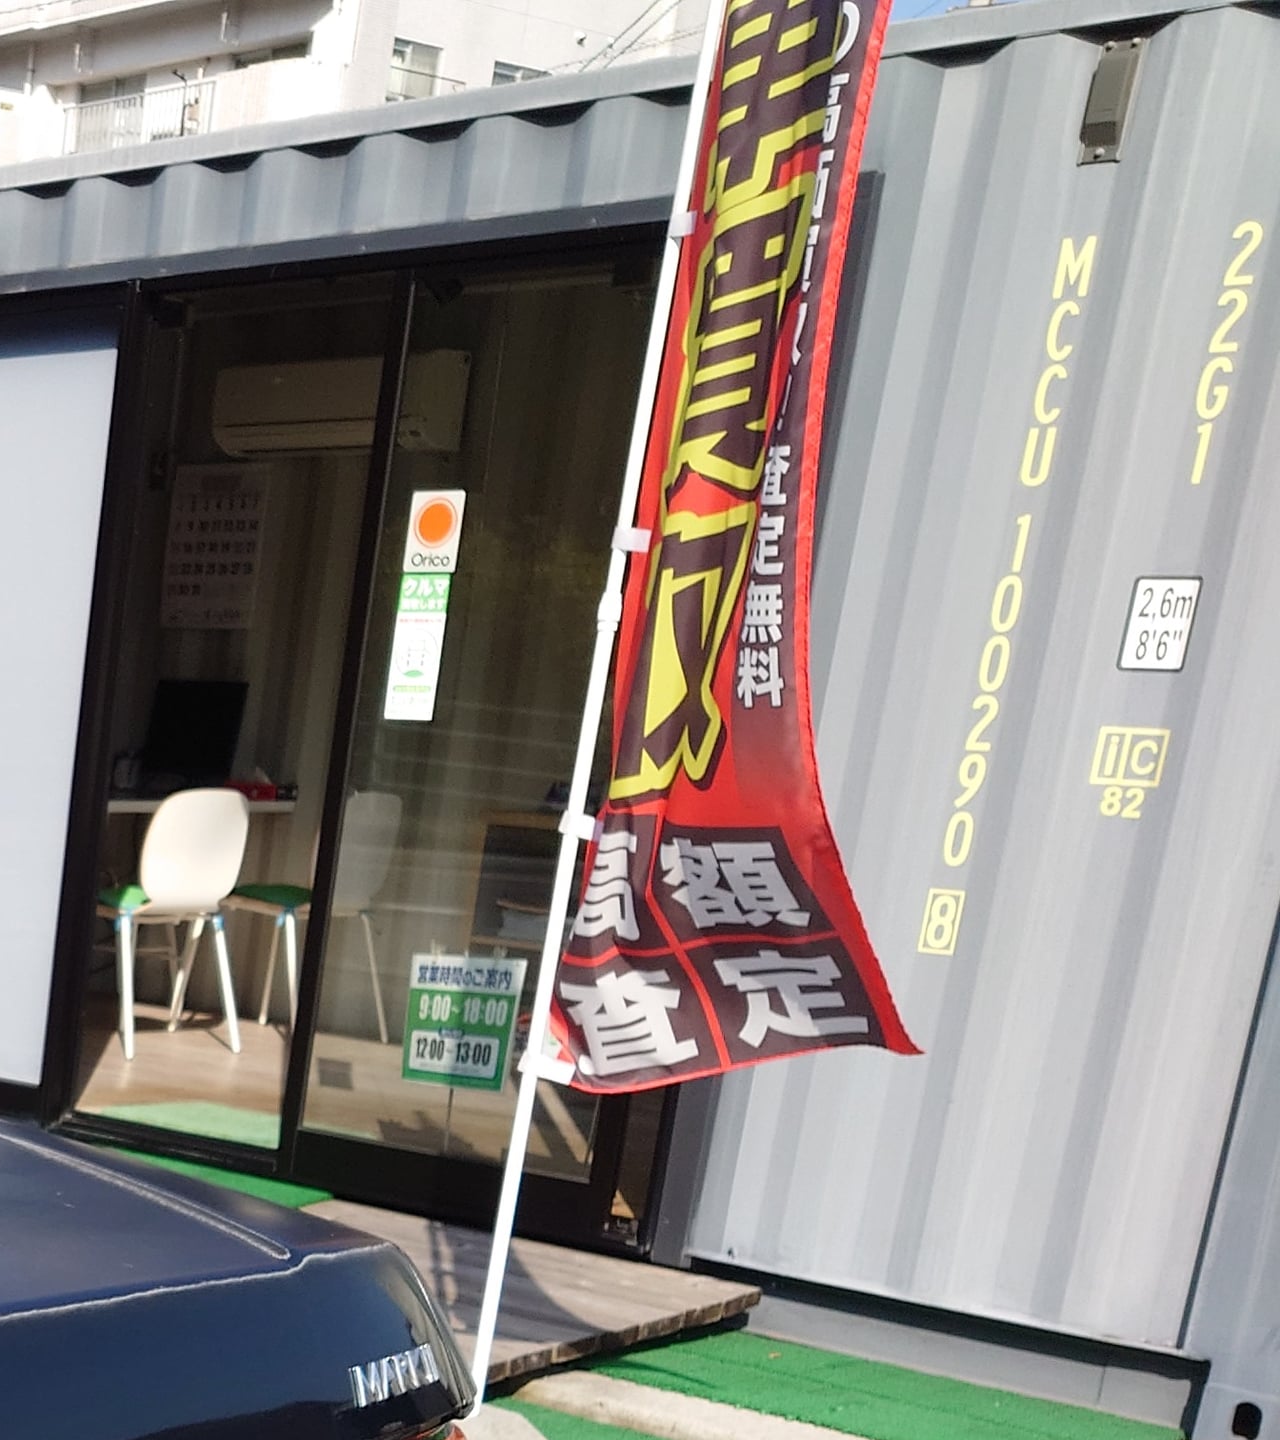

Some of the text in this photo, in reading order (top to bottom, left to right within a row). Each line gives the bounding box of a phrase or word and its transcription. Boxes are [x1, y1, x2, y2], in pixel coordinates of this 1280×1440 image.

[1190, 221, 1264, 485] 22G1
[411, 552, 450, 567] Orico
[737, 445, 791, 708] 査定無料
[923, 235, 1098, 951] MCCU 100290 8
[1100, 786, 1145, 819] 82
[417, 964, 512, 990] 営業時間のご案内
[559, 950, 870, 1077] 査定
